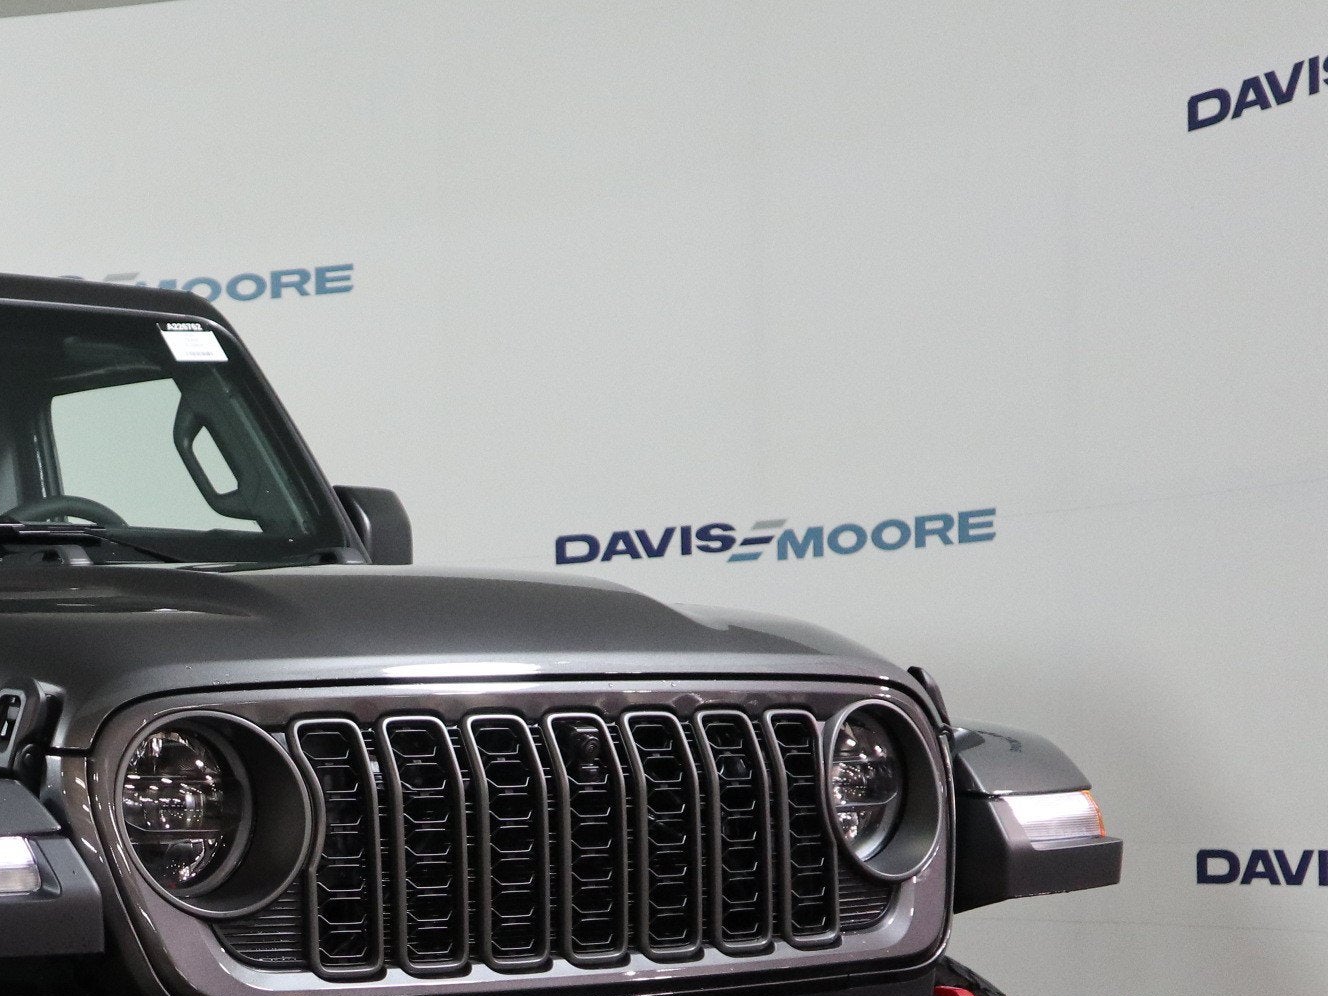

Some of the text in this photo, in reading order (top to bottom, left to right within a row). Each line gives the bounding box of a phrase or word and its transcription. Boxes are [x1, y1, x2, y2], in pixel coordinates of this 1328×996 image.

[1187, 54, 1328, 132] DAVI
[134, 263, 354, 301] OORE
[555, 507, 997, 565] DAVIS MOORE
